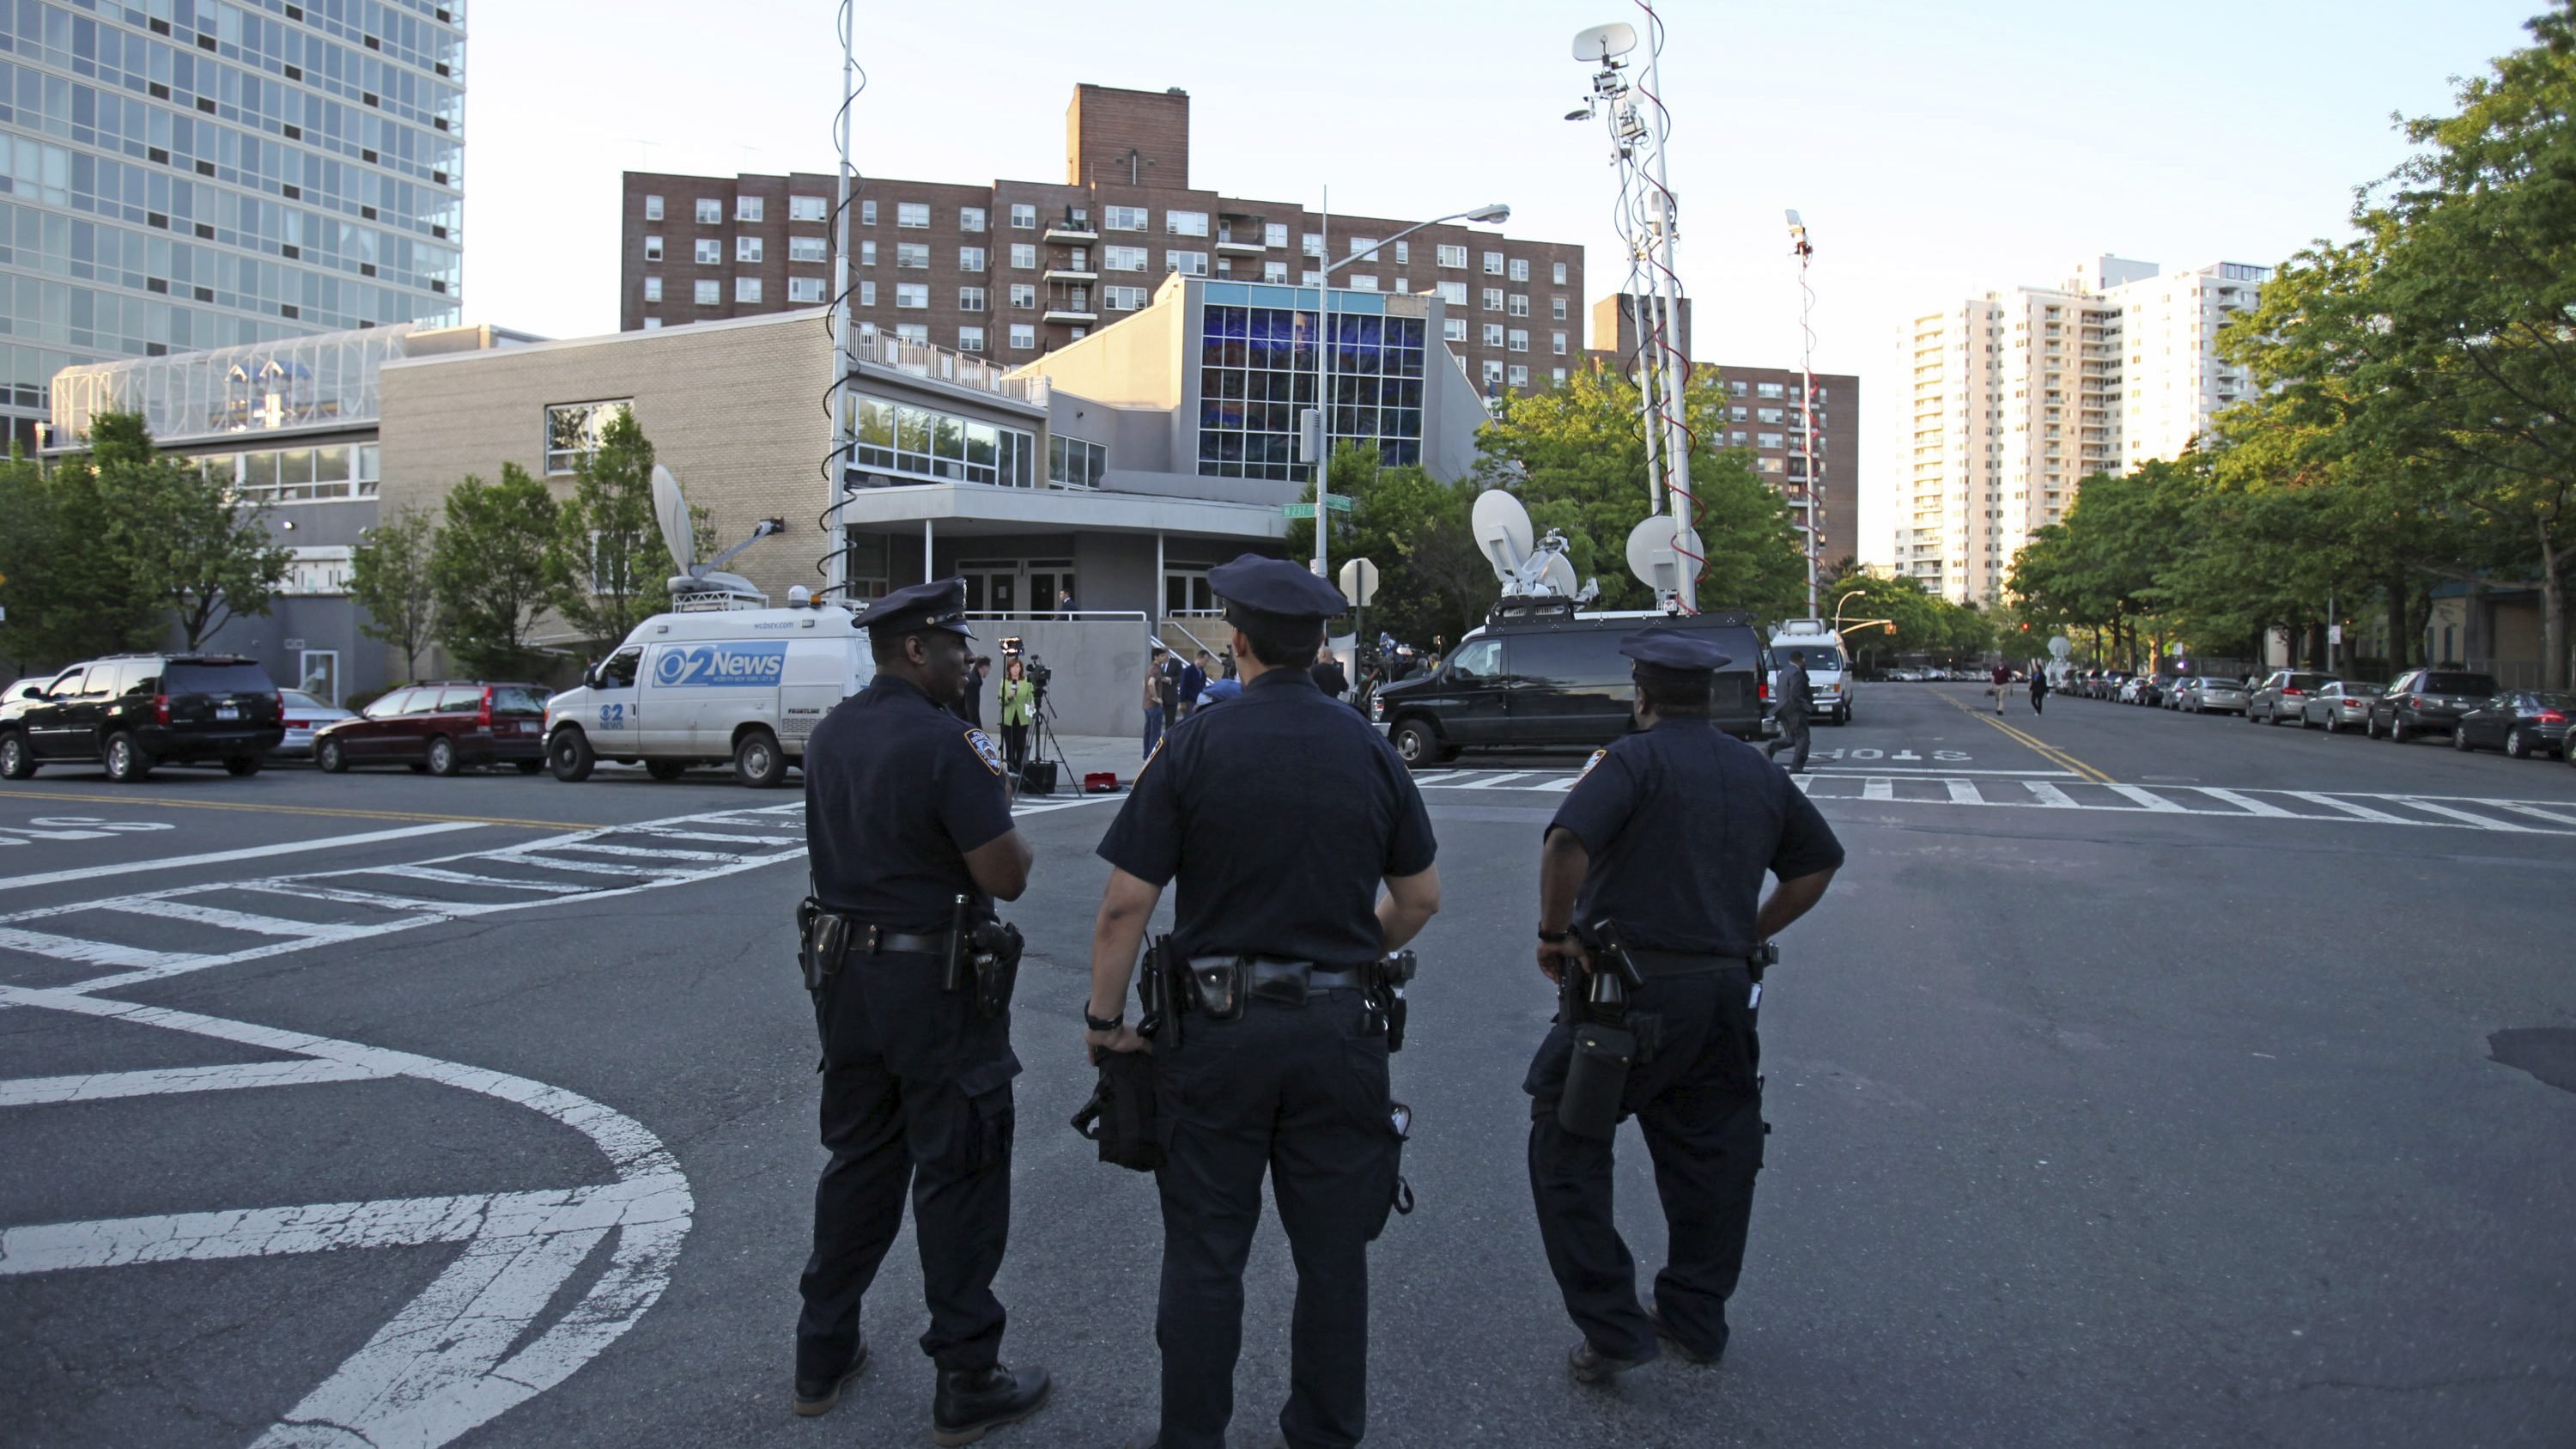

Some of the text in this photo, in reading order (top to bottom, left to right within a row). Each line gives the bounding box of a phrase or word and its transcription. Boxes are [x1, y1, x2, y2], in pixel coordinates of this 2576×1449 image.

[1284, 507, 1291, 516] W
[1291, 506, 1305, 516] 237
[680, 646, 781, 685] 2 News
[611, 703, 623, 721] 2
[600, 721, 624, 730] NEWS
